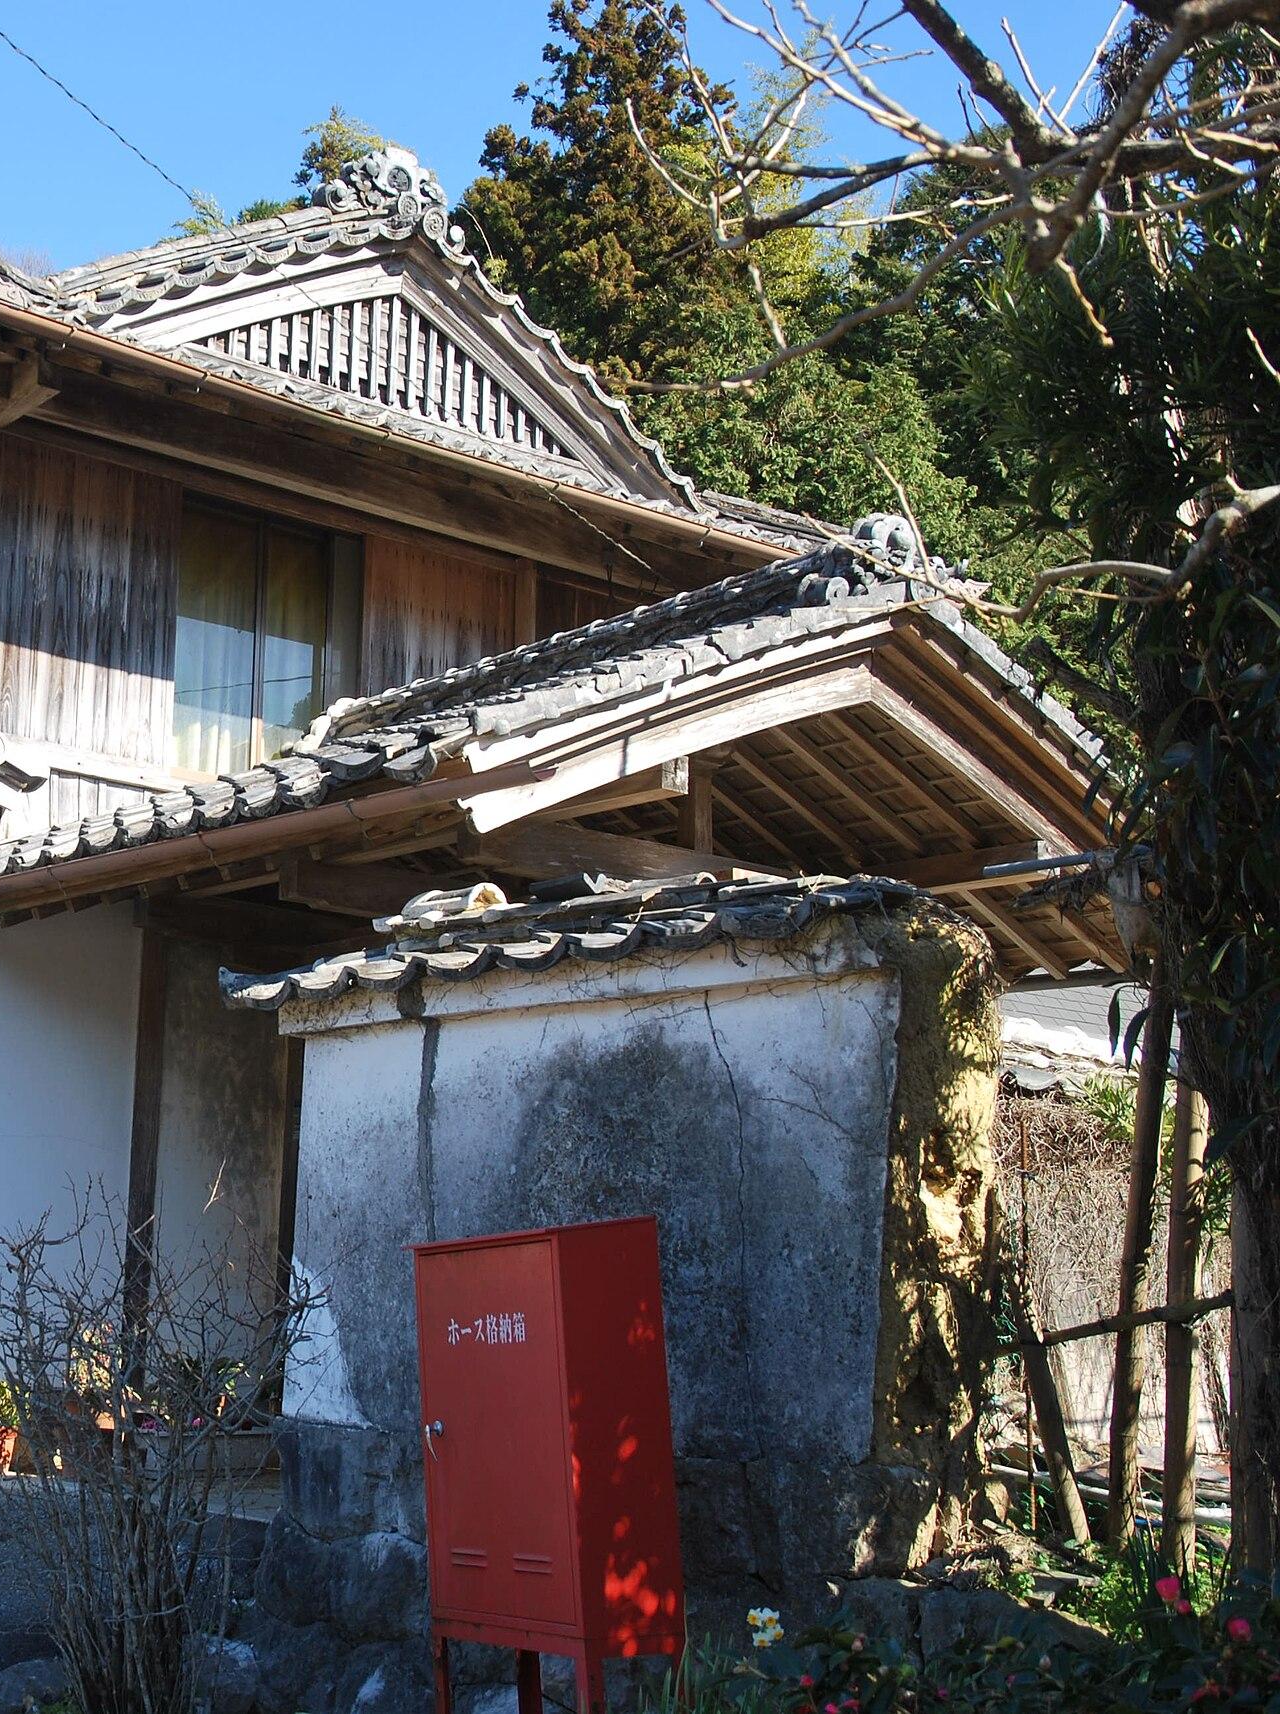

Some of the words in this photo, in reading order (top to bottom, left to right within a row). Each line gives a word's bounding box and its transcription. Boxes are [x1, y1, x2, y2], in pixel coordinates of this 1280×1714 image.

[448, 1312, 525, 1345] ホース格納箱
